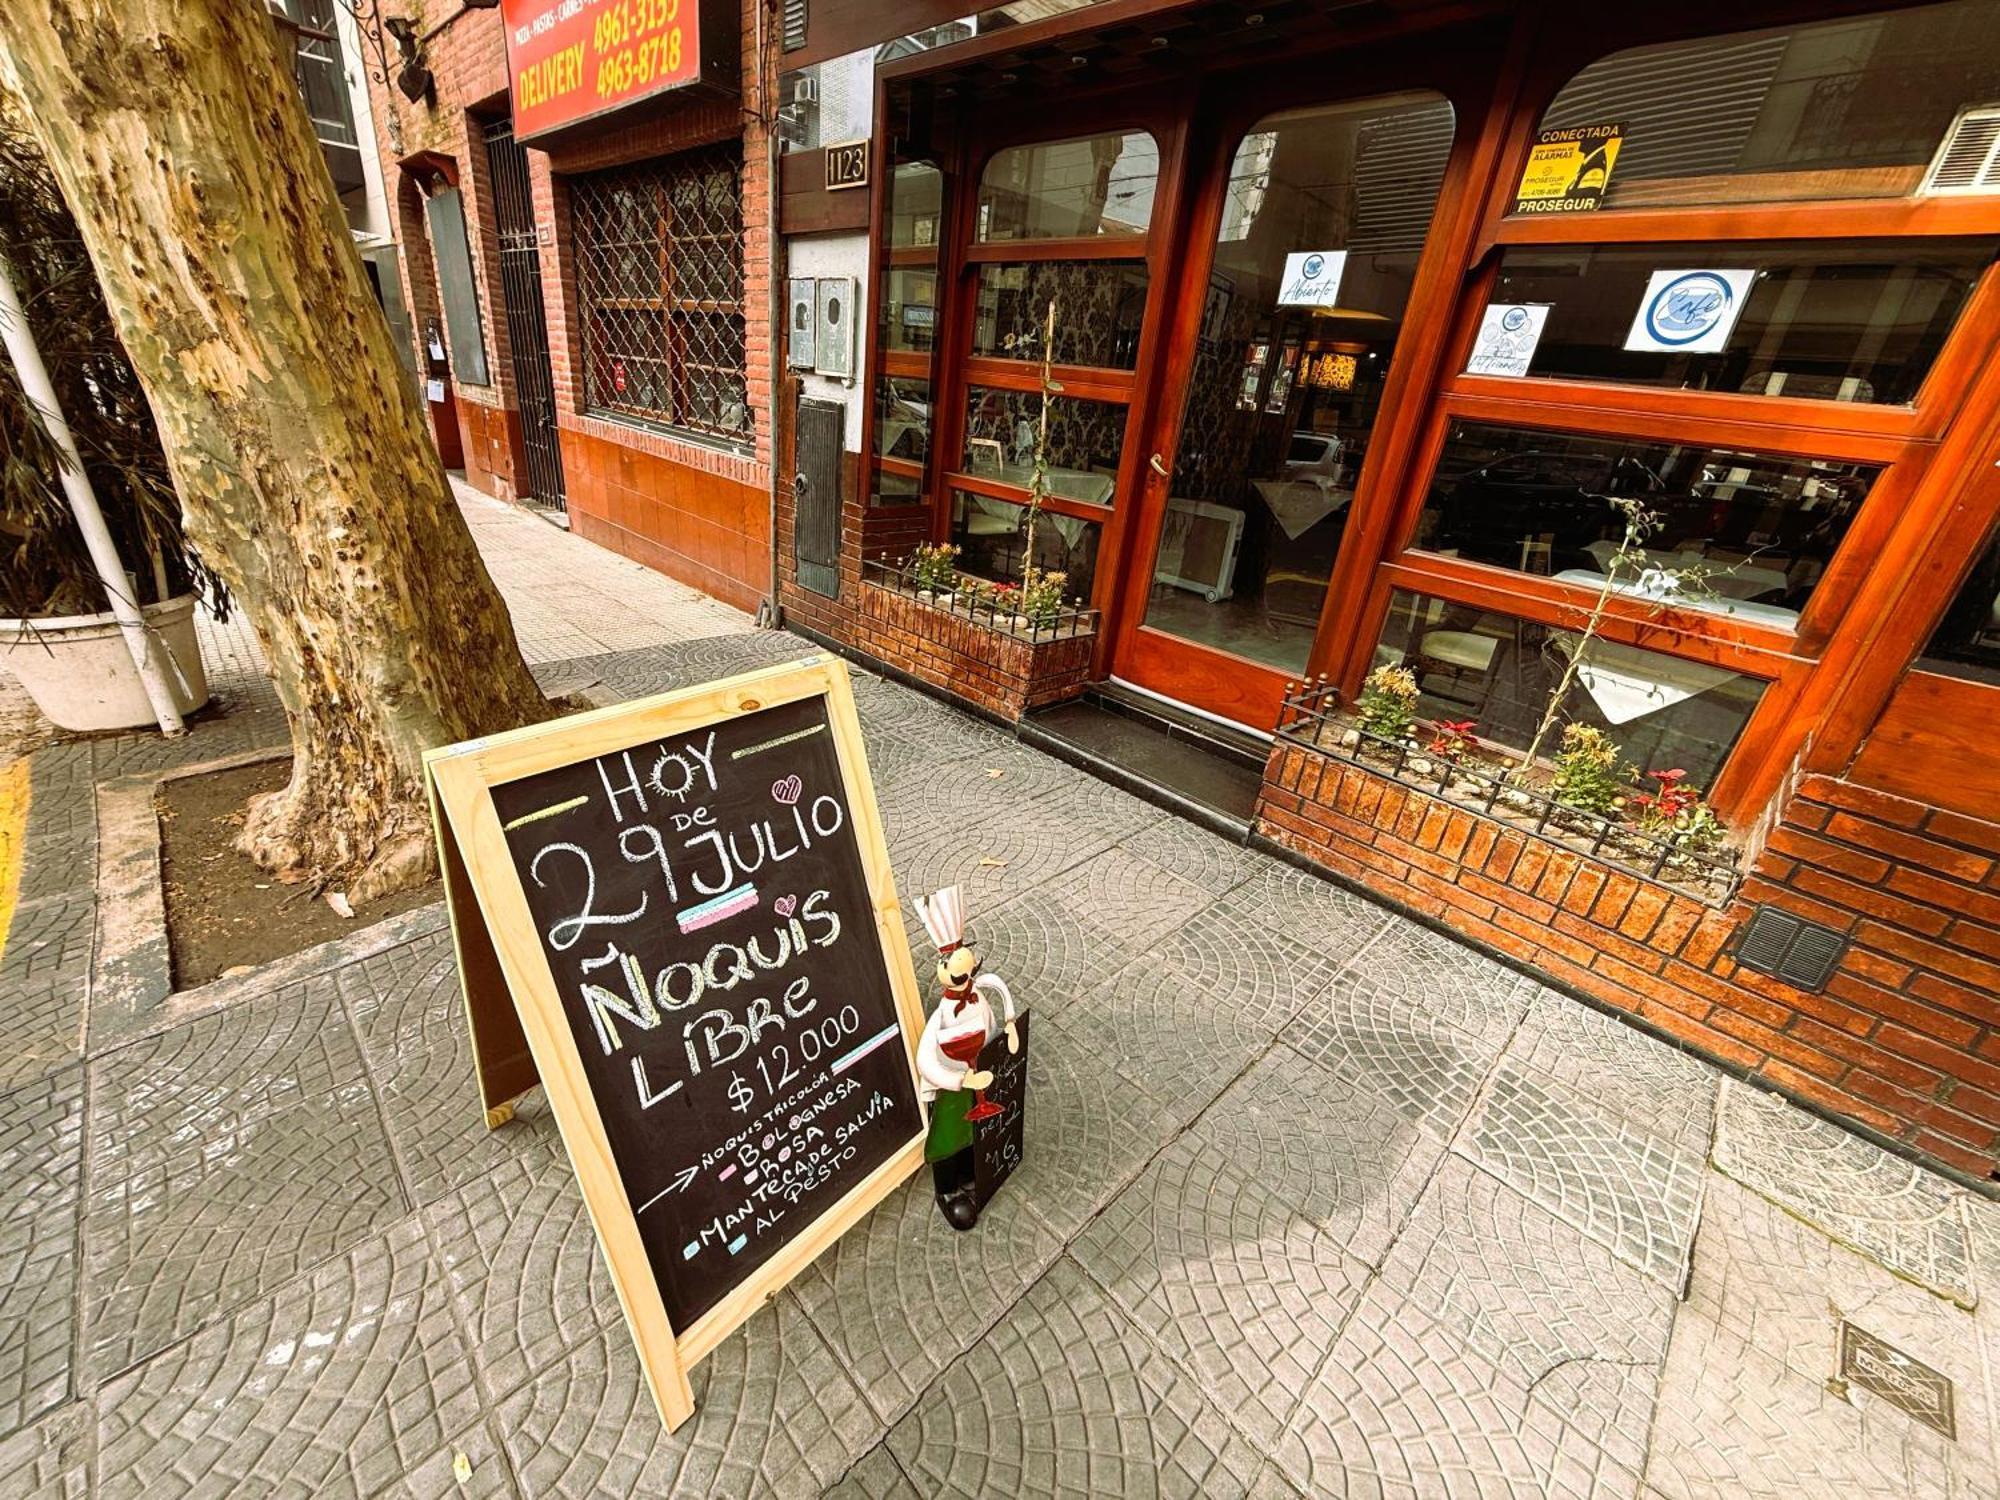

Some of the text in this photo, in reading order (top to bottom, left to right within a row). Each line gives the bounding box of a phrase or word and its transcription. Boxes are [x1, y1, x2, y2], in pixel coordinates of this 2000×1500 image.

[519, 40, 585, 112] DELIVERY
[596, 27, 682, 99] 4963-8718
[1541, 125, 1619, 143] CONECTADA
[830, 148, 863, 182] 1123
[1518, 198, 1595, 213] PROSEGUR
[1282, 278, 1336, 304] Abierto
[596, 732, 718, 822] HOY
[531, 824, 678, 950] 29
[684, 796, 843, 894] JULIO
[759, 1126, 824, 1179] ROSA
[755, 1209, 786, 1235] AL
